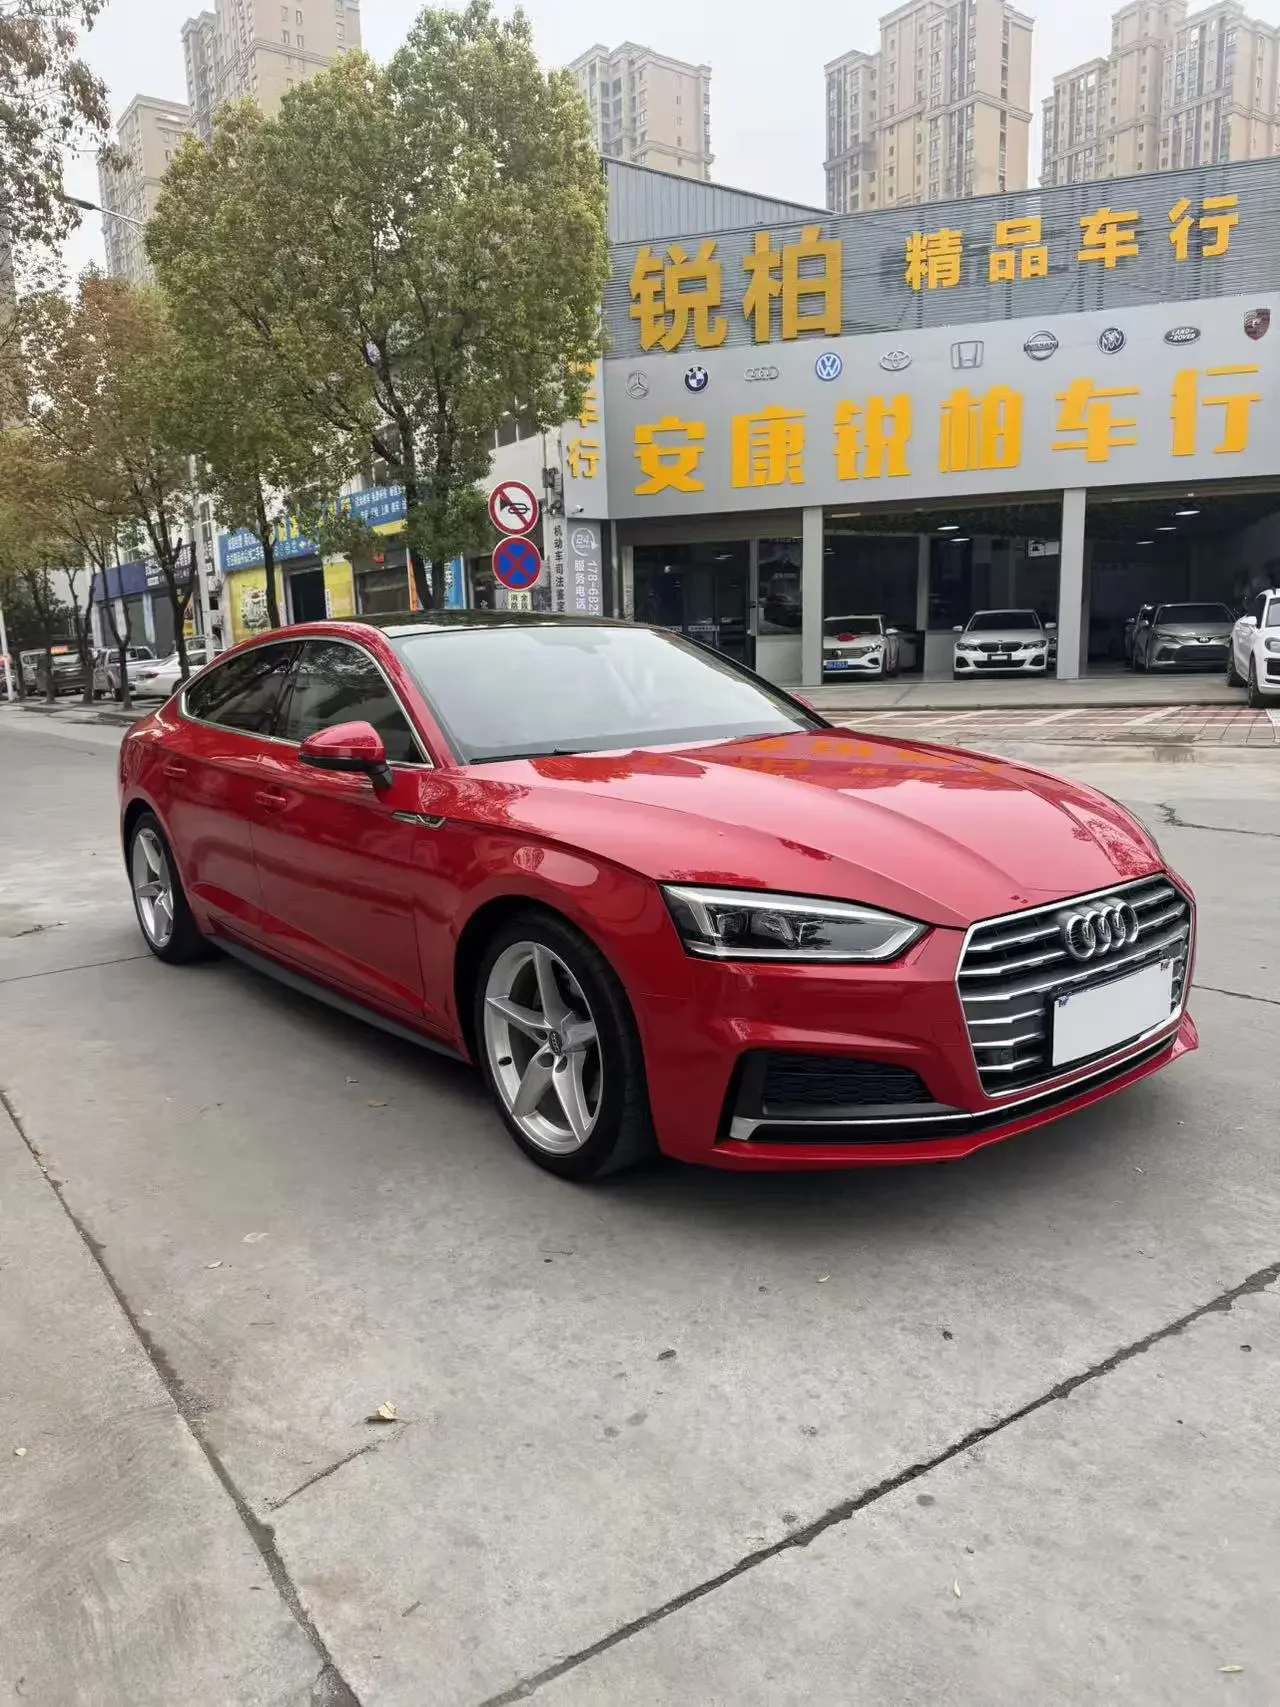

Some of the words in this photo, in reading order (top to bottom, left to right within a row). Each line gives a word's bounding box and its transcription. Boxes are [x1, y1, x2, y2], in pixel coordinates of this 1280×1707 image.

[629, 225, 843, 352] 锐柏
[904, 194, 1240, 292] 精品车行
[633, 364, 1263, 495] 安康锐柏车行
